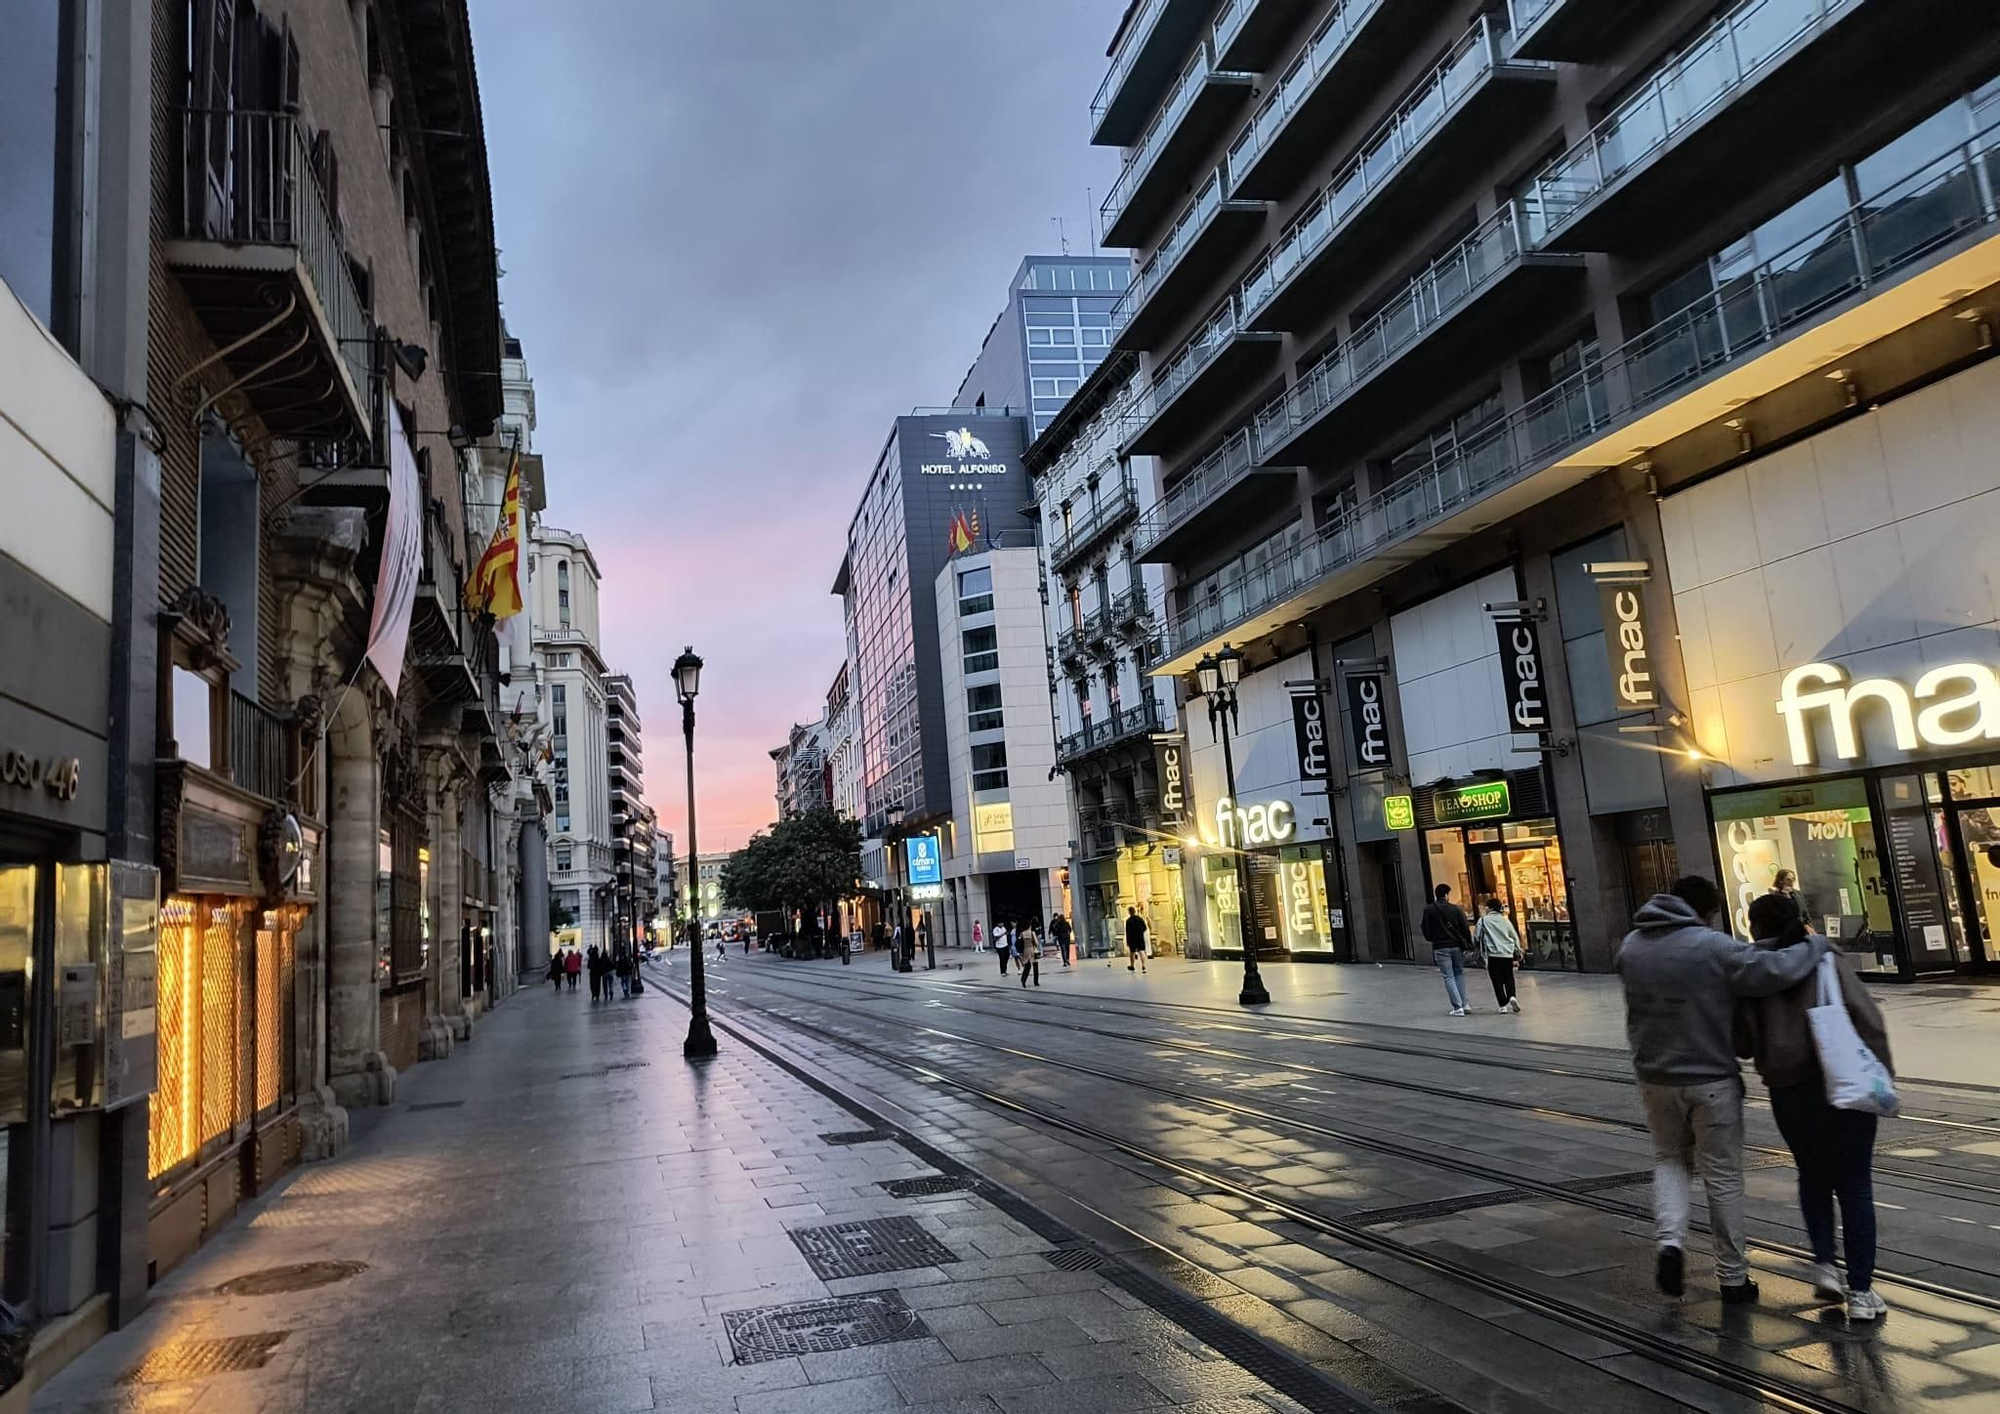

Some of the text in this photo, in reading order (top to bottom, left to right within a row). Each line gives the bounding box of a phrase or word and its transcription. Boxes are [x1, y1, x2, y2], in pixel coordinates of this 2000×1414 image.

[921, 464, 1007, 474] HOTEL ALFONSO
[1615, 591, 1653, 703] fnac
[1512, 627, 1544, 727] fnac
[1304, 700, 1327, 776] fnac
[1360, 680, 1386, 763] fnac
[1775, 662, 2000, 766] fna
[46, 757, 80, 800] 46
[1164, 749, 1183, 810] fnac
[1387, 798, 1408, 807] TEA
[1439, 791, 1501, 811] TEA SHOP
[1216, 797, 1291, 848] fnac
[1642, 813, 1660, 831] 27
[1860, 847, 1876, 859] fn
[1290, 862, 1314, 935] fnac
[1985, 888, 2000, 901] fn
